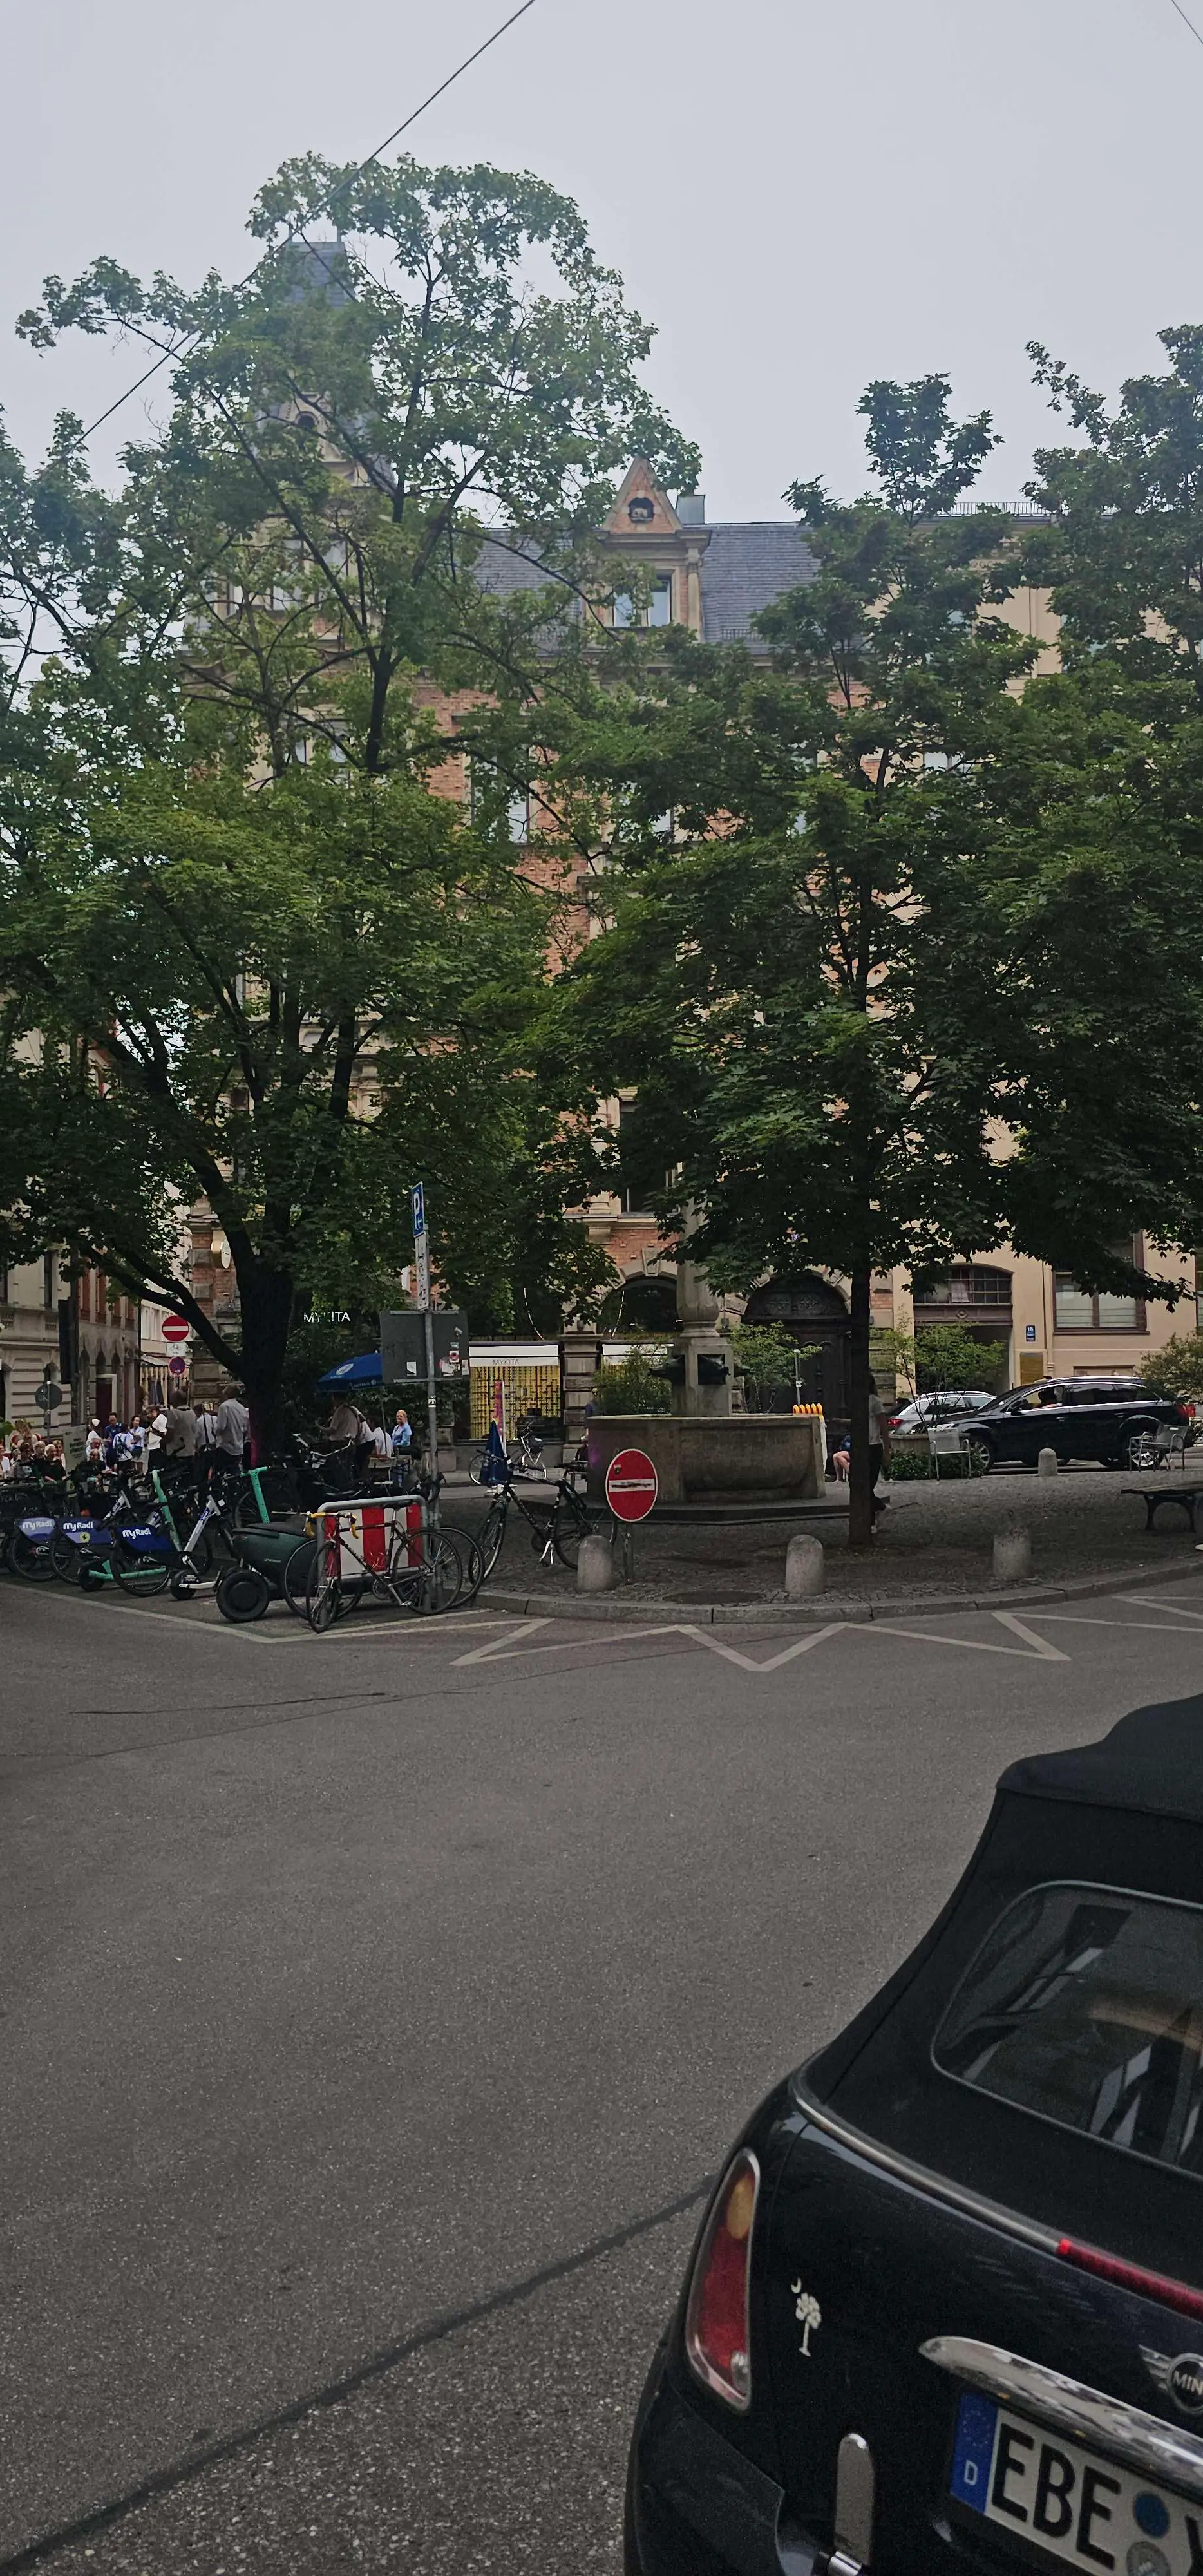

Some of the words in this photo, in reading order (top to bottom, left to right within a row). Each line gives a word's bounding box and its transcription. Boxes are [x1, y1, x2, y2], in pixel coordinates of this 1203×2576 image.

[413, 1192, 420, 1230] P
[303, 1311, 351, 1323] MYITA
[963, 2459, 978, 2486] D
[991, 2423, 1121, 2571] EBE
